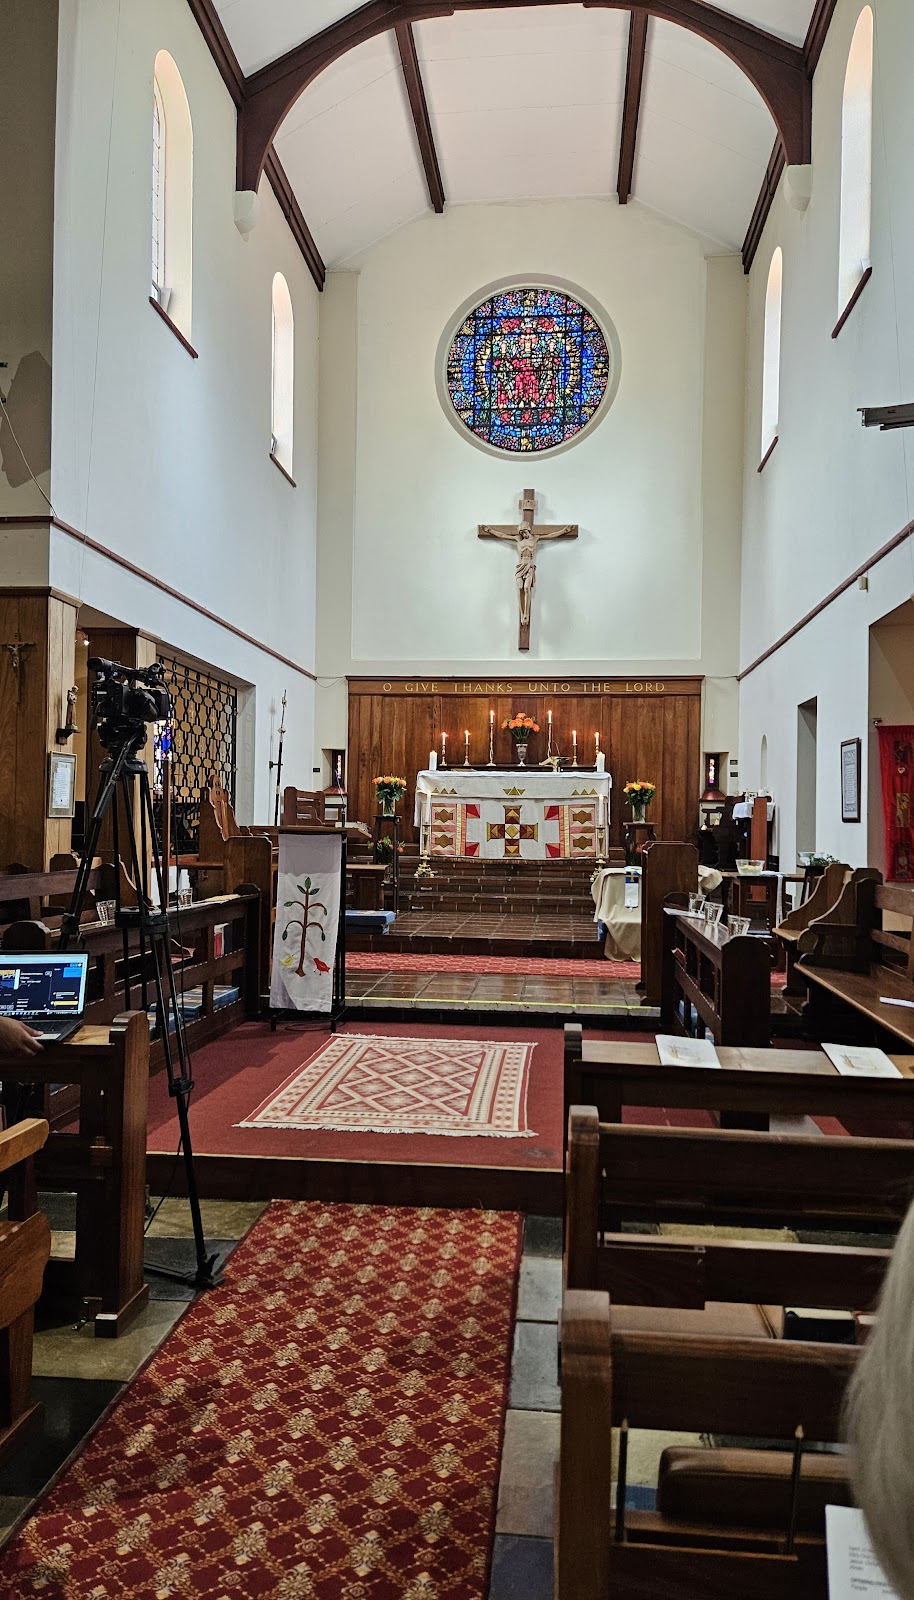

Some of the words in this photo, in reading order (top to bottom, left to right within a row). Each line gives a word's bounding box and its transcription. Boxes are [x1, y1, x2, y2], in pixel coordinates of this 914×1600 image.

[382, 682, 392, 692] O
[405, 682, 438, 692] GIVE
[453, 682, 513, 693] THANKS
[528, 682, 571, 692] UNTO
[581, 682, 610, 692] THE
[626, 682, 665, 692] LORD
